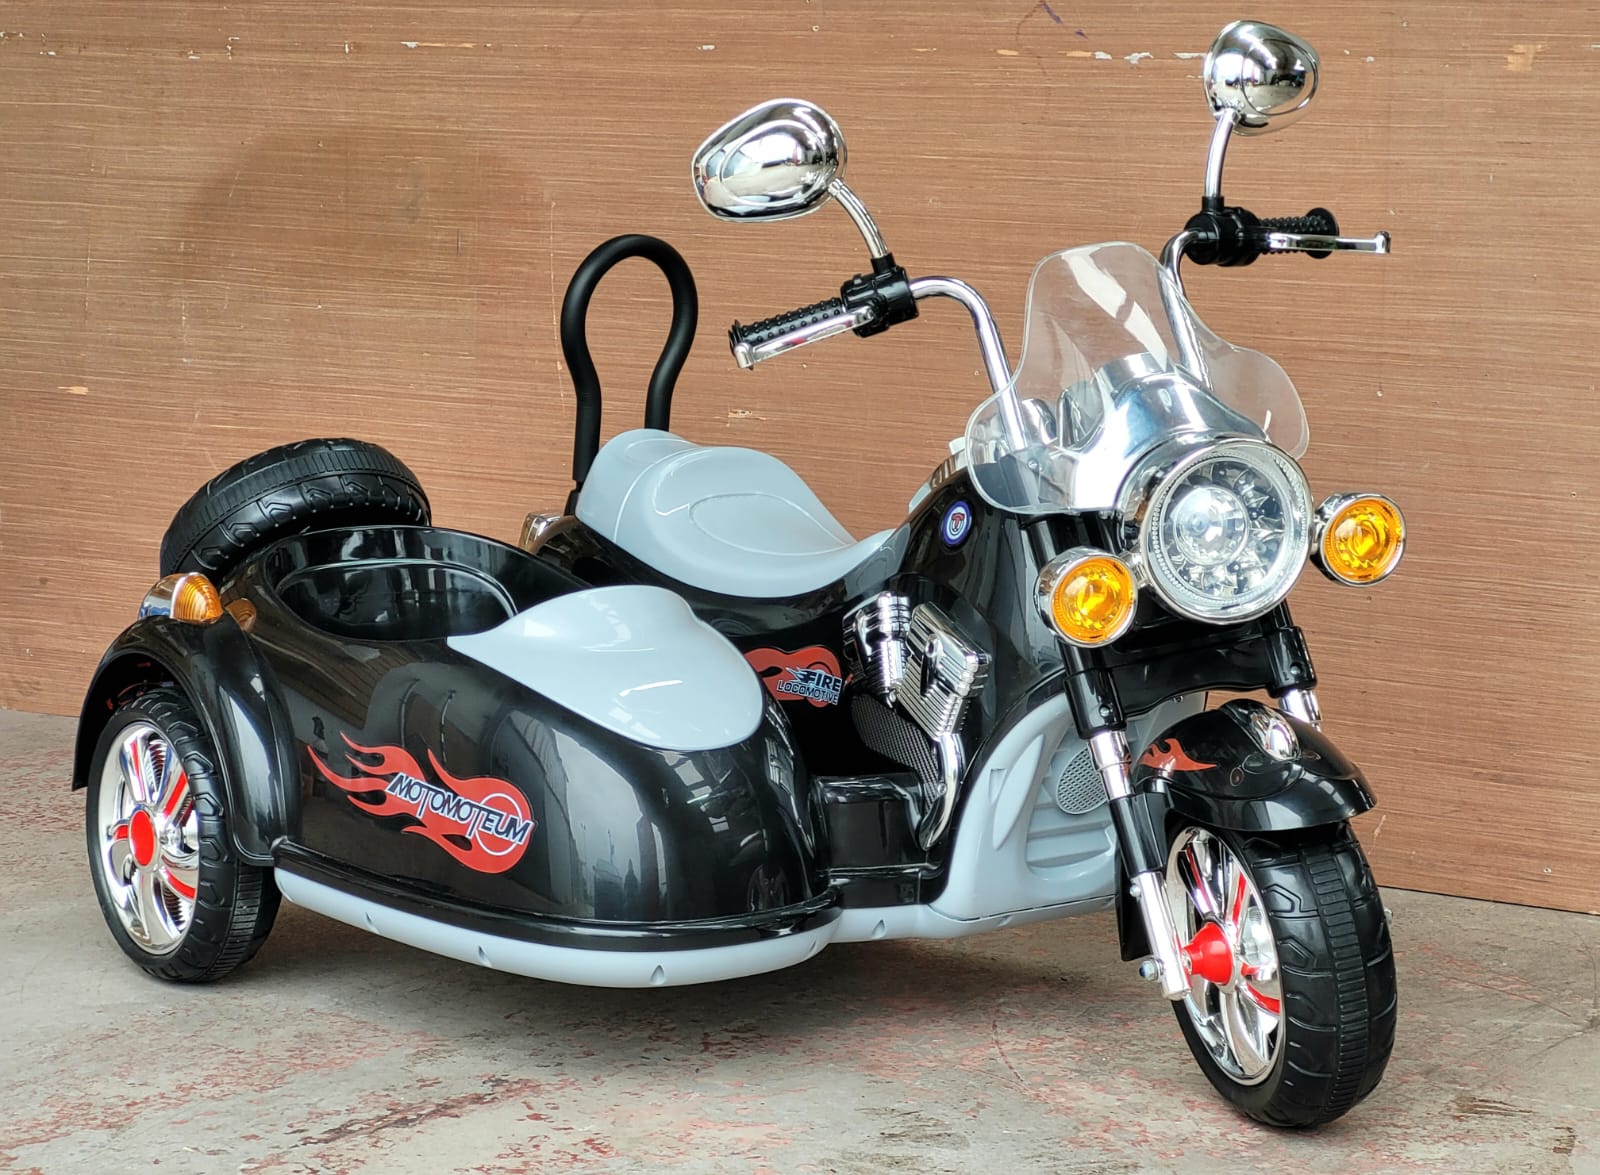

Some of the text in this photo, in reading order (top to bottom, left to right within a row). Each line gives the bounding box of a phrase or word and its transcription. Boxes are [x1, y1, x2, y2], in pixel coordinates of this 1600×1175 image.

[777, 680, 840, 705] LOCOMOTIVE
[796, 668, 842, 693] FIRE
[386, 773, 534, 844] MOTOMOTEUM
